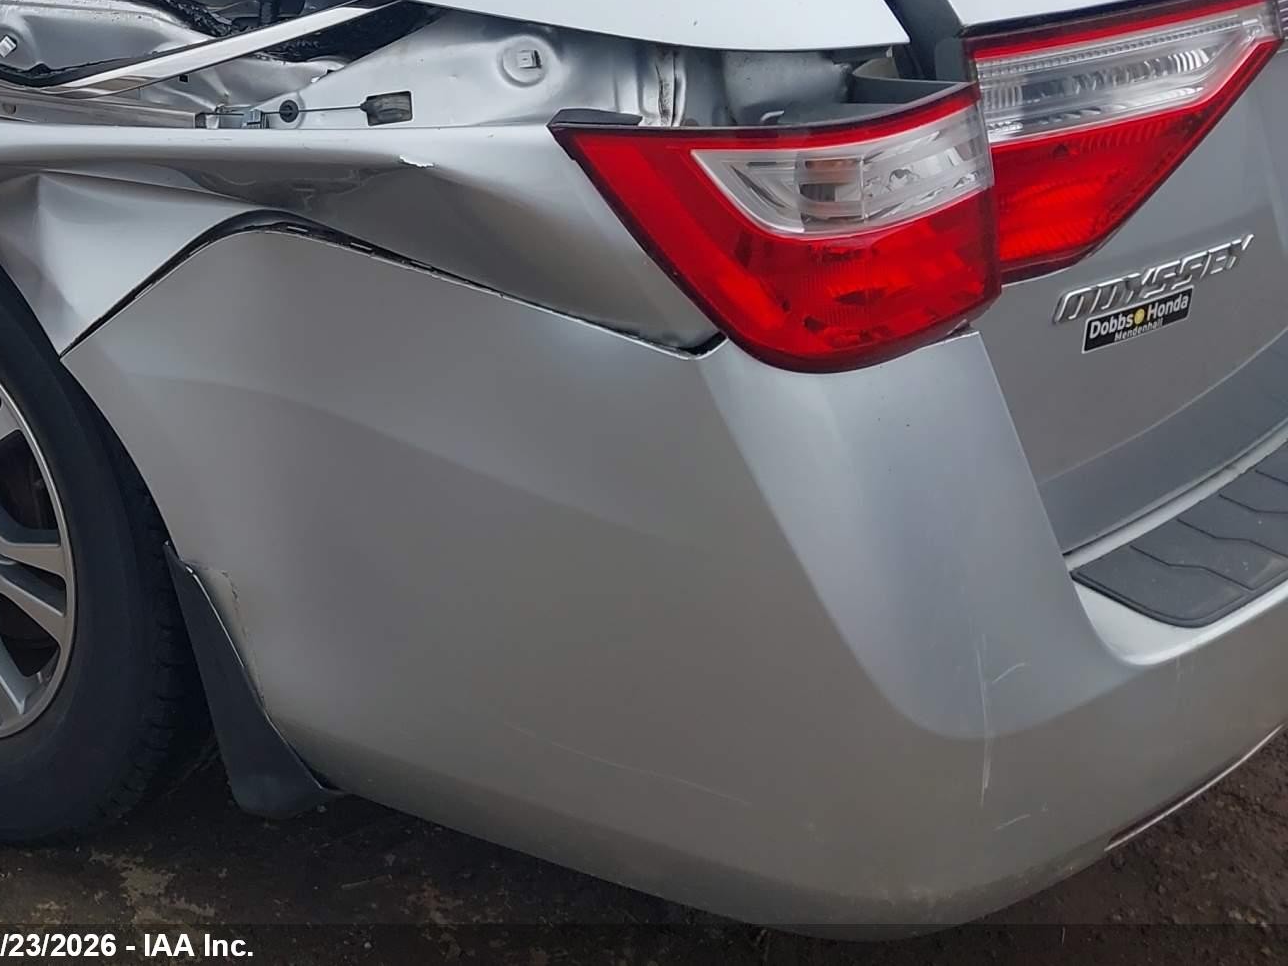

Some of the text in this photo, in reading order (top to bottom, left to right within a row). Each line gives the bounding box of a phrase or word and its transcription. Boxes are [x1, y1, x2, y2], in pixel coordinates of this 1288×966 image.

[1053, 233, 1254, 324] ODYSSEY
[1089, 293, 1190, 339] Dobbs Honda
[1114, 317, 1164, 342] Mendenhall
